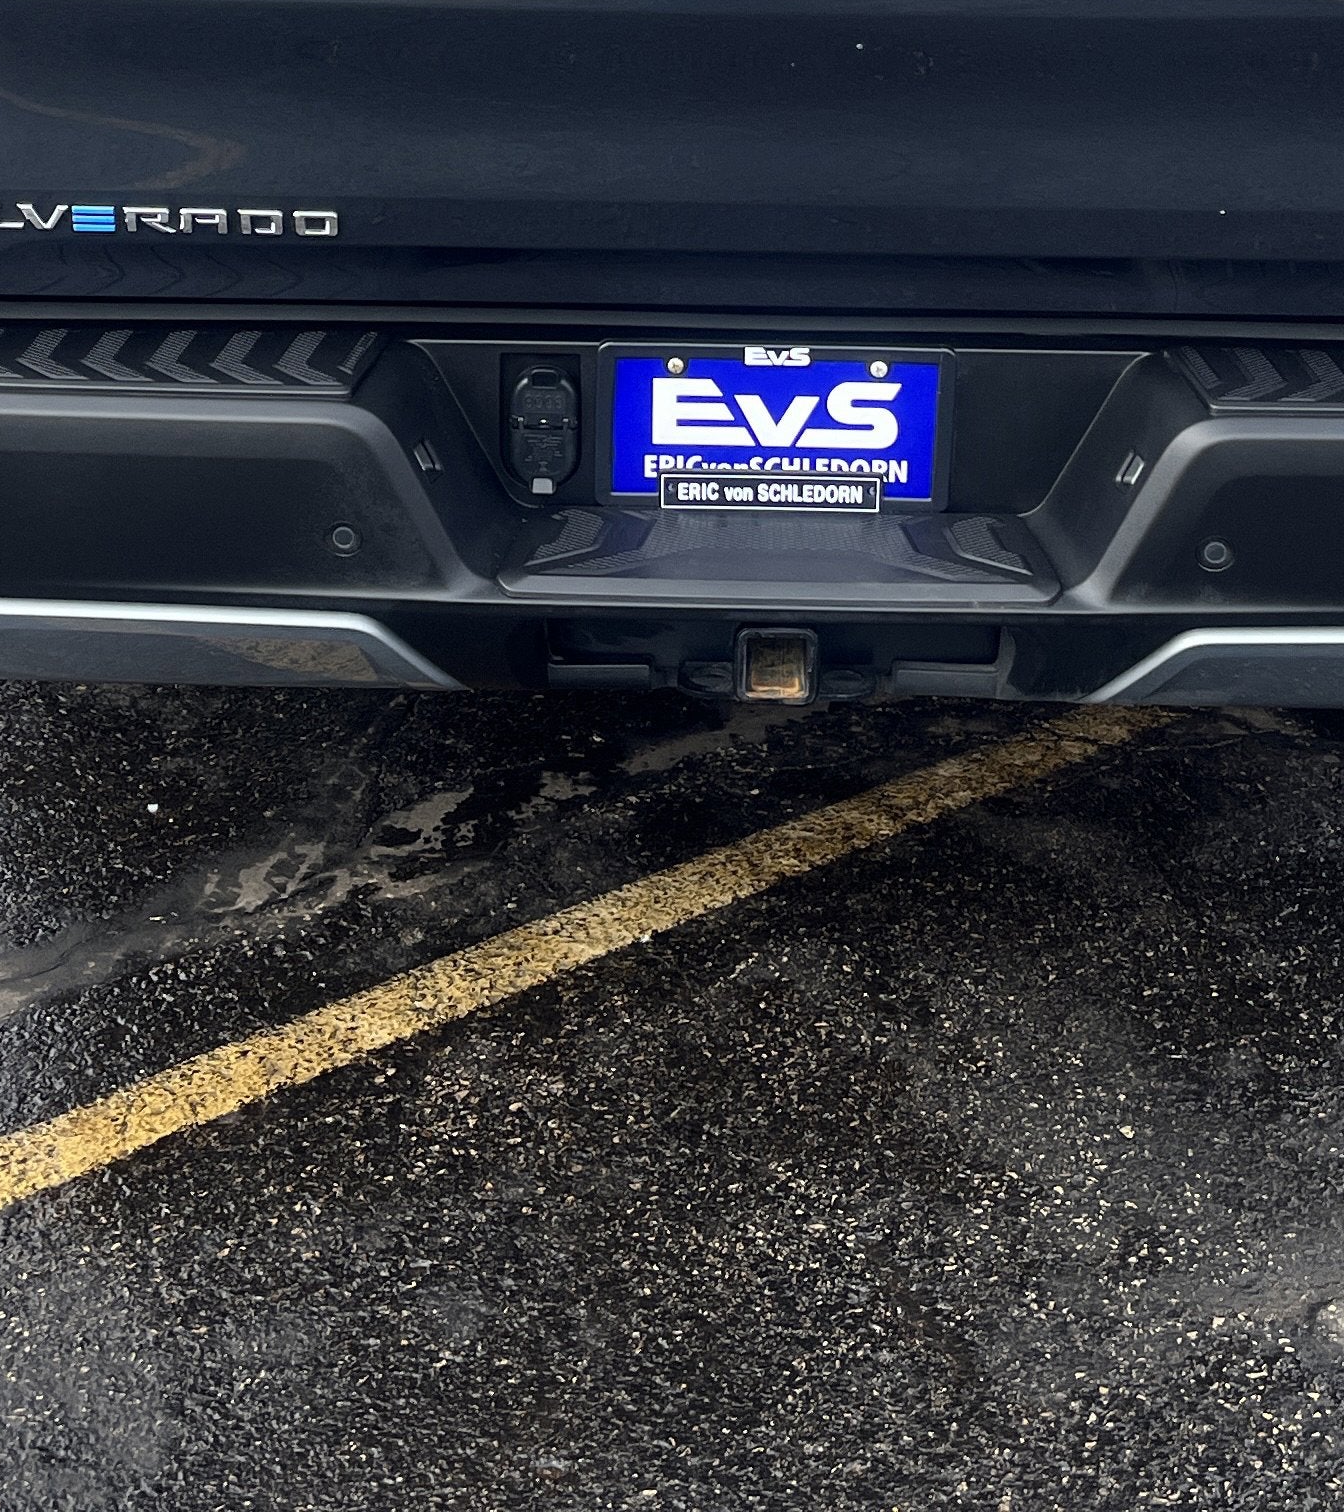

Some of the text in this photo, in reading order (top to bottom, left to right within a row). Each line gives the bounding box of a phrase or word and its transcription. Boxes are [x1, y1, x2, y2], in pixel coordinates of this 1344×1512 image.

[677, 482, 863, 504] ERIC von SCHLEDORN
